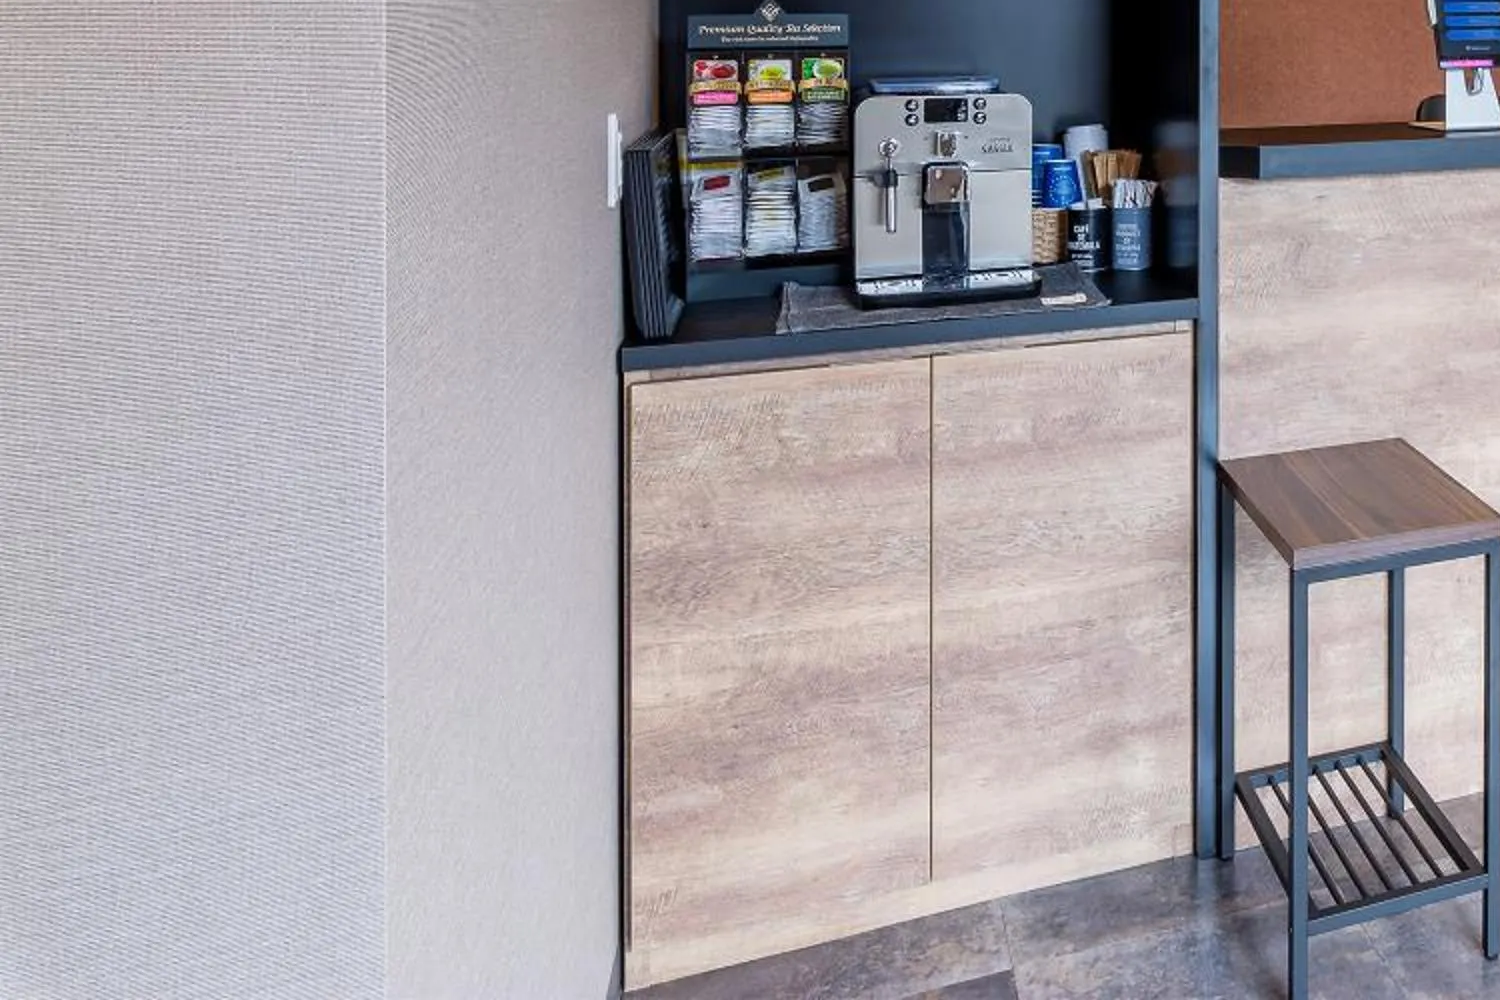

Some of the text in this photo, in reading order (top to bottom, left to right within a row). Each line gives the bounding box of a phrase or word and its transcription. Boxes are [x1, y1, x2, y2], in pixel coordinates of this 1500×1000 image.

[699, 25, 745, 35] Premium
[747, 24, 783, 35] Quality
[802, 23, 841, 34] Selection
